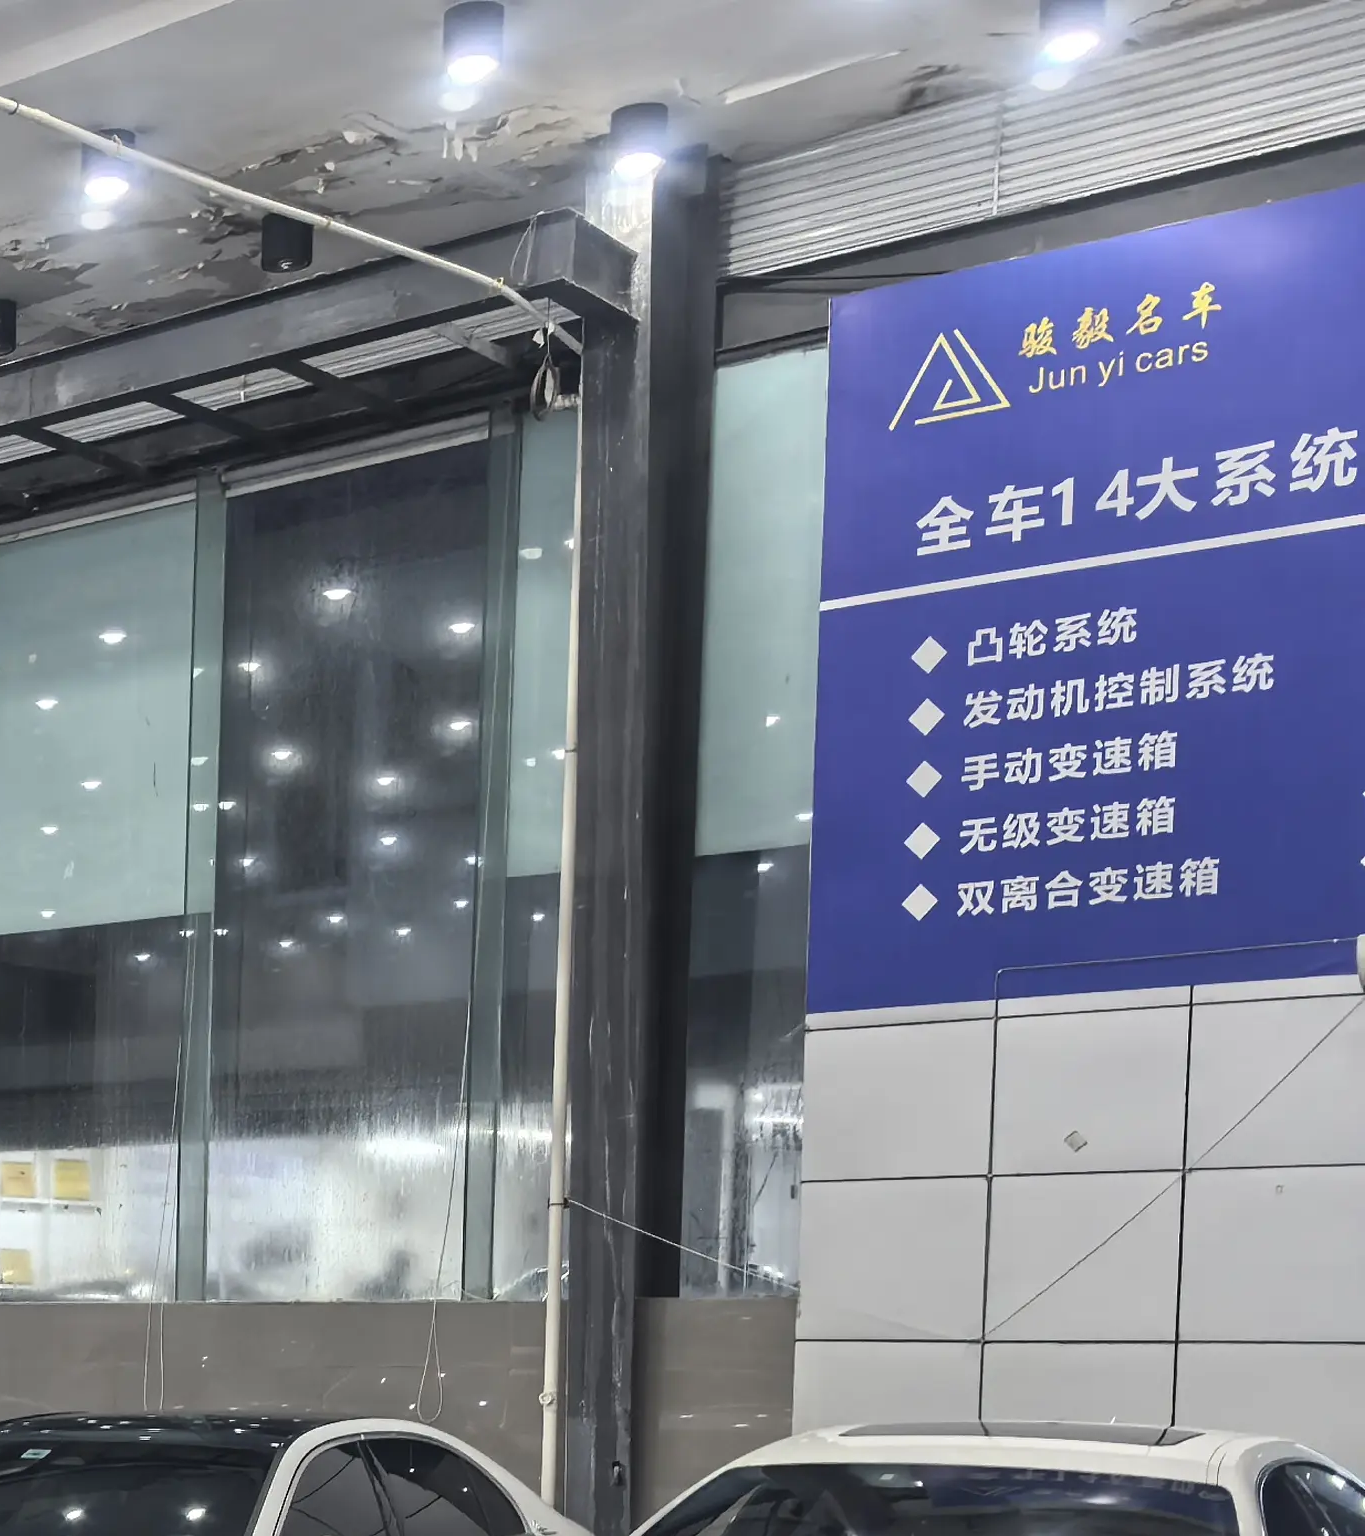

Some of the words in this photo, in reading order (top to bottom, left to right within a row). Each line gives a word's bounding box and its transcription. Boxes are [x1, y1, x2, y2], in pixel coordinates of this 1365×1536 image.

[1028, 365, 1087, 394] Jun
[1097, 350, 1125, 387] yi
[1135, 340, 1209, 373] cars
[915, 428, 1358, 557] 全车14大系统
[967, 607, 1138, 666] 凸轮系统
[962, 653, 1275, 729] 发动机控制系统
[960, 731, 1178, 791] 手动变速箱
[958, 795, 1176, 855] 无级变速箱
[955, 856, 1220, 918] 双离合变速箱
